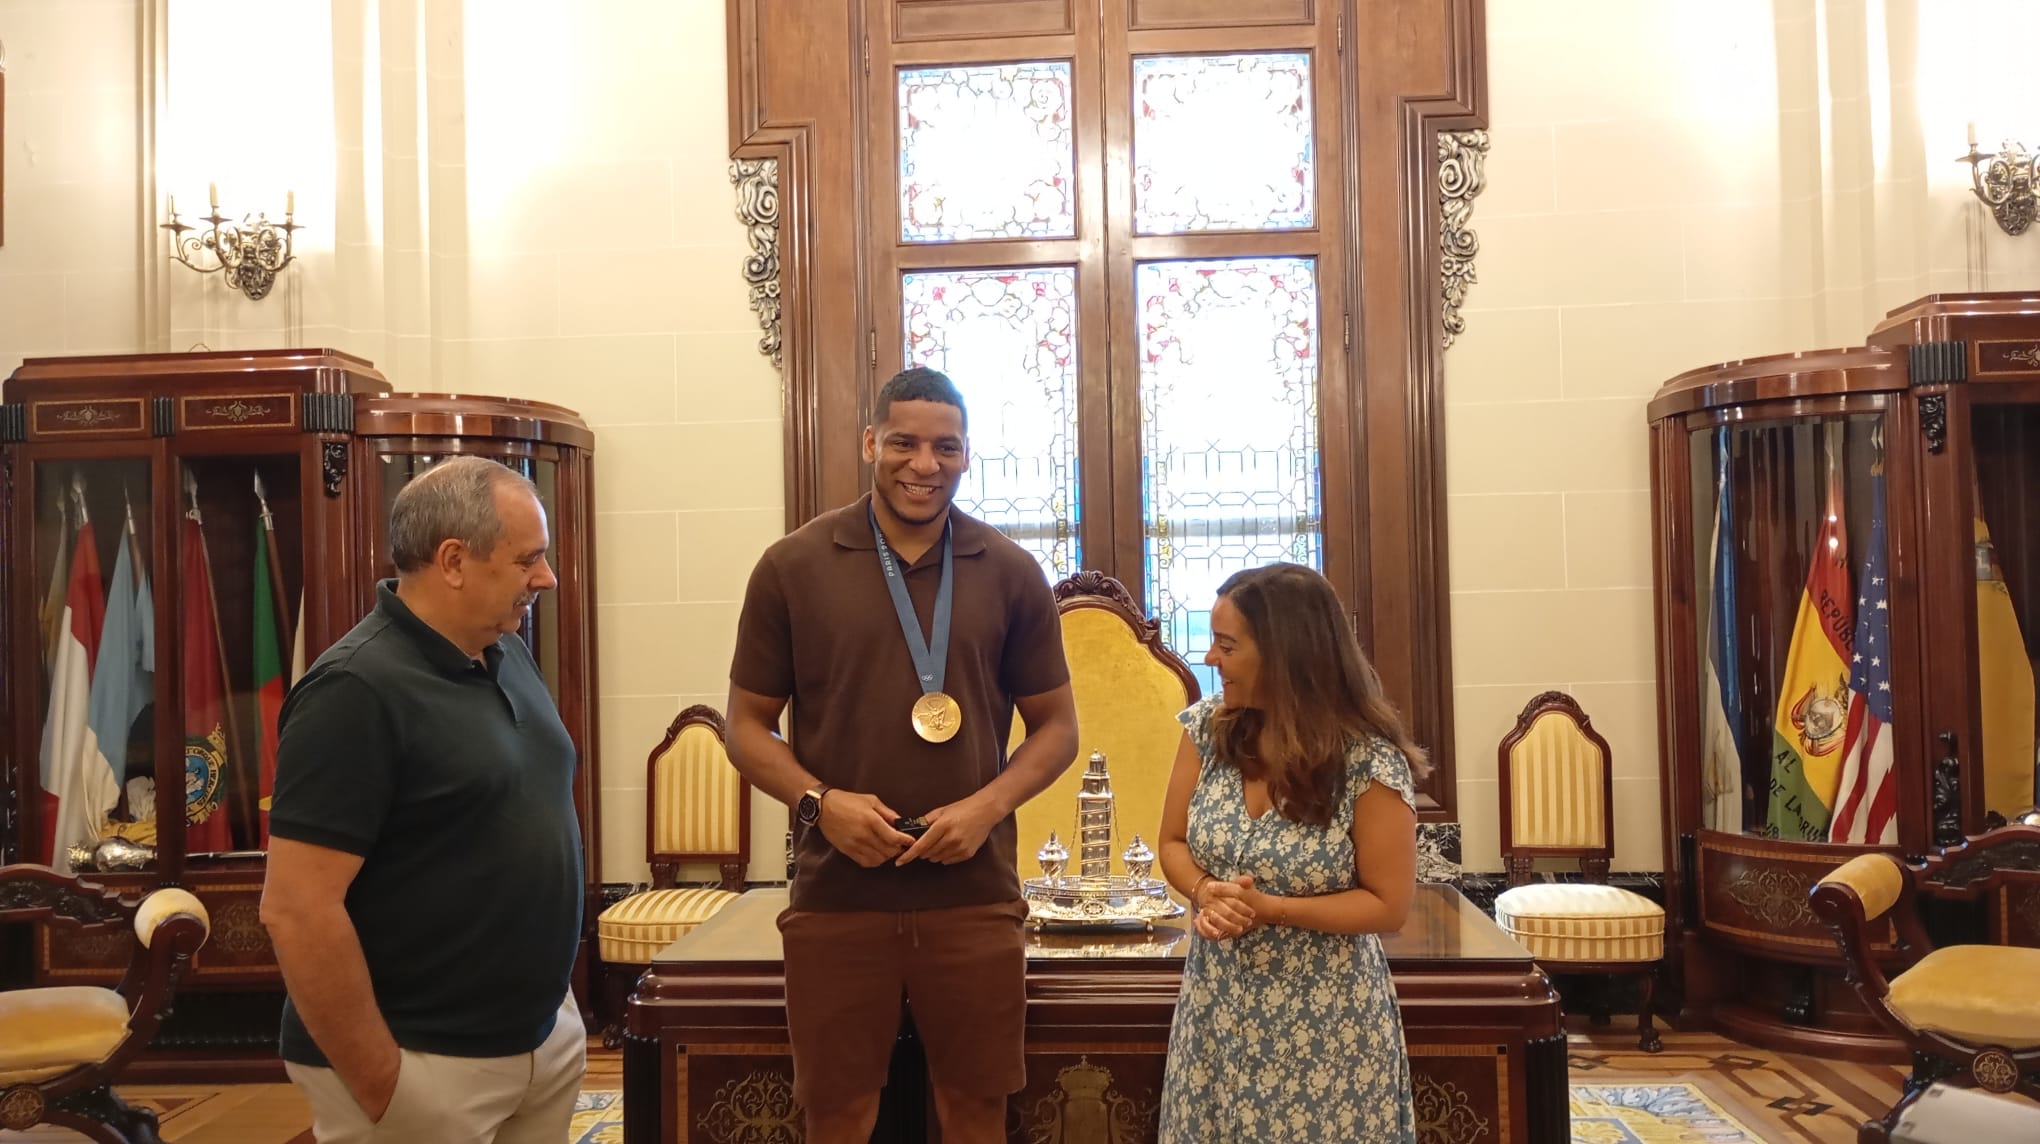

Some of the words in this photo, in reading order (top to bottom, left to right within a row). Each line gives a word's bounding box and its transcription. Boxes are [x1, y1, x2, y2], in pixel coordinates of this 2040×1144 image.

[882, 551, 895, 577] PARIS
[1776, 750, 1797, 774] AL
[1768, 778, 1787, 797] DE
[1784, 795, 1802, 816] LA
